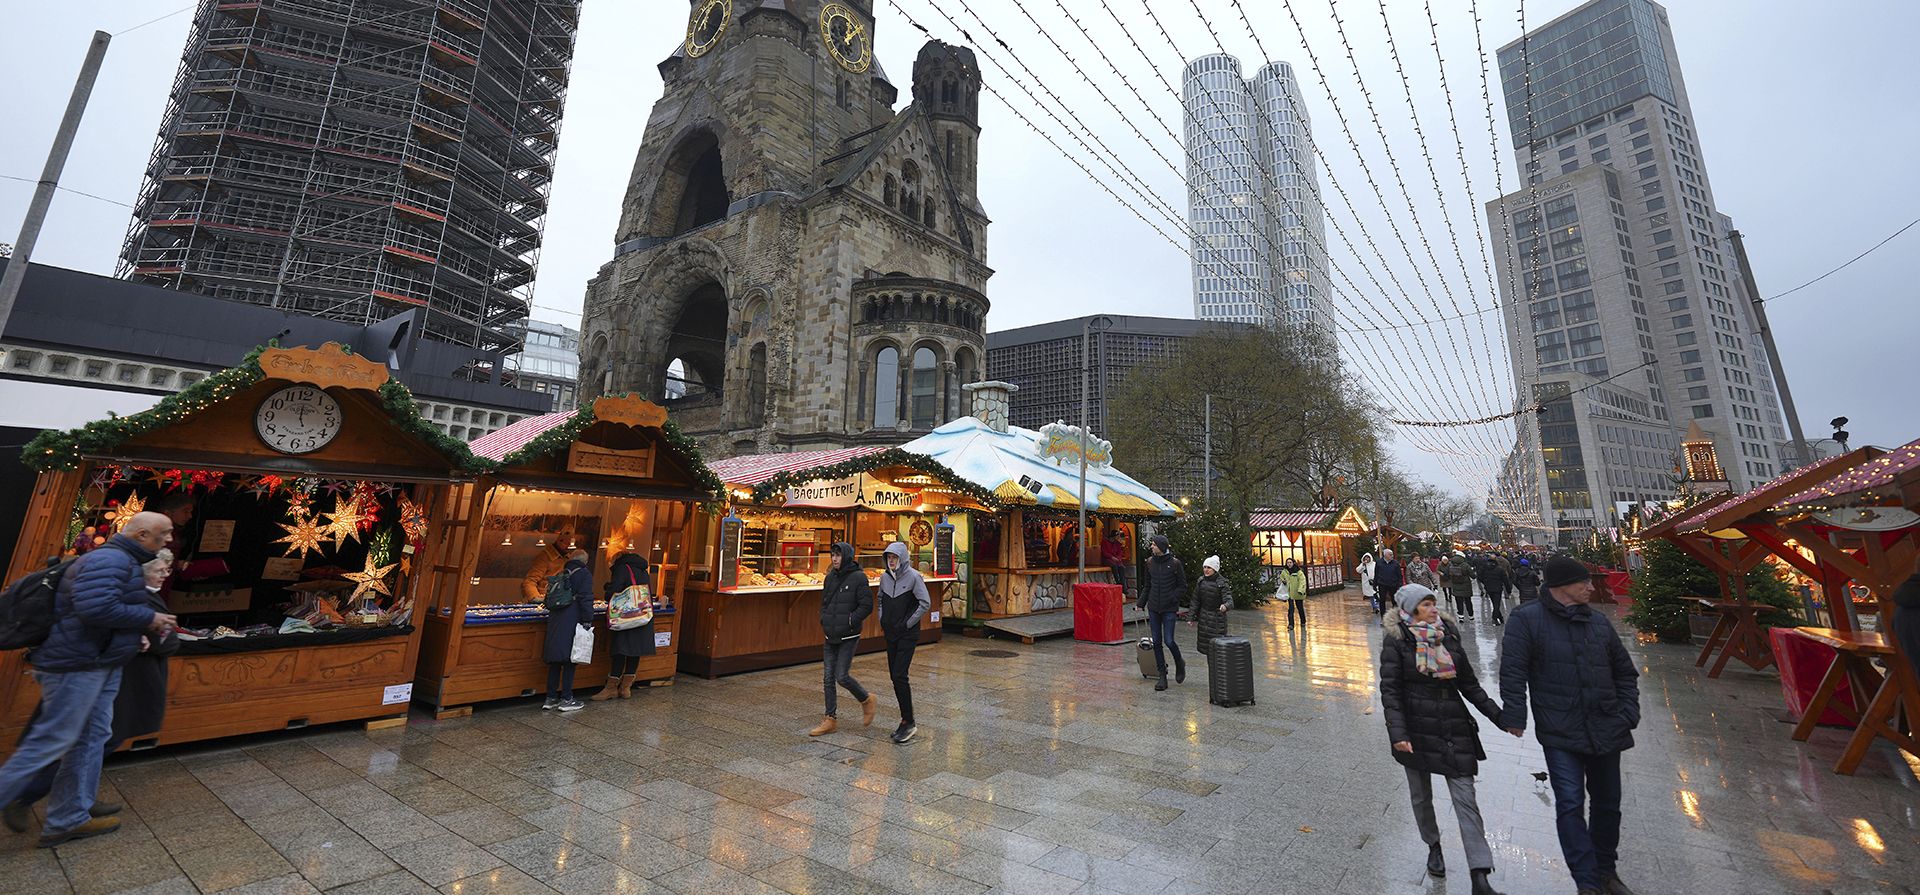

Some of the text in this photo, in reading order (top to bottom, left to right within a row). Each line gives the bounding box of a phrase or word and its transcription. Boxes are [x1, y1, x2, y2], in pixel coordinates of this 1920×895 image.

[286, 391, 296, 402] 11
[298, 390, 313, 401] 12
[318, 396, 323, 406] 1
[270, 399, 284, 410] 10
[324, 405, 335, 416] 2
[264, 411, 275, 422] 9
[324, 417, 336, 428] 3
[265, 423, 276, 435] 8
[317, 428, 328, 439] 4
[277, 434, 286, 446] 7
[290, 438, 300, 450] 6
[305, 436, 316, 447] 5
[793, 483, 855, 500] BAGUETTERIE
